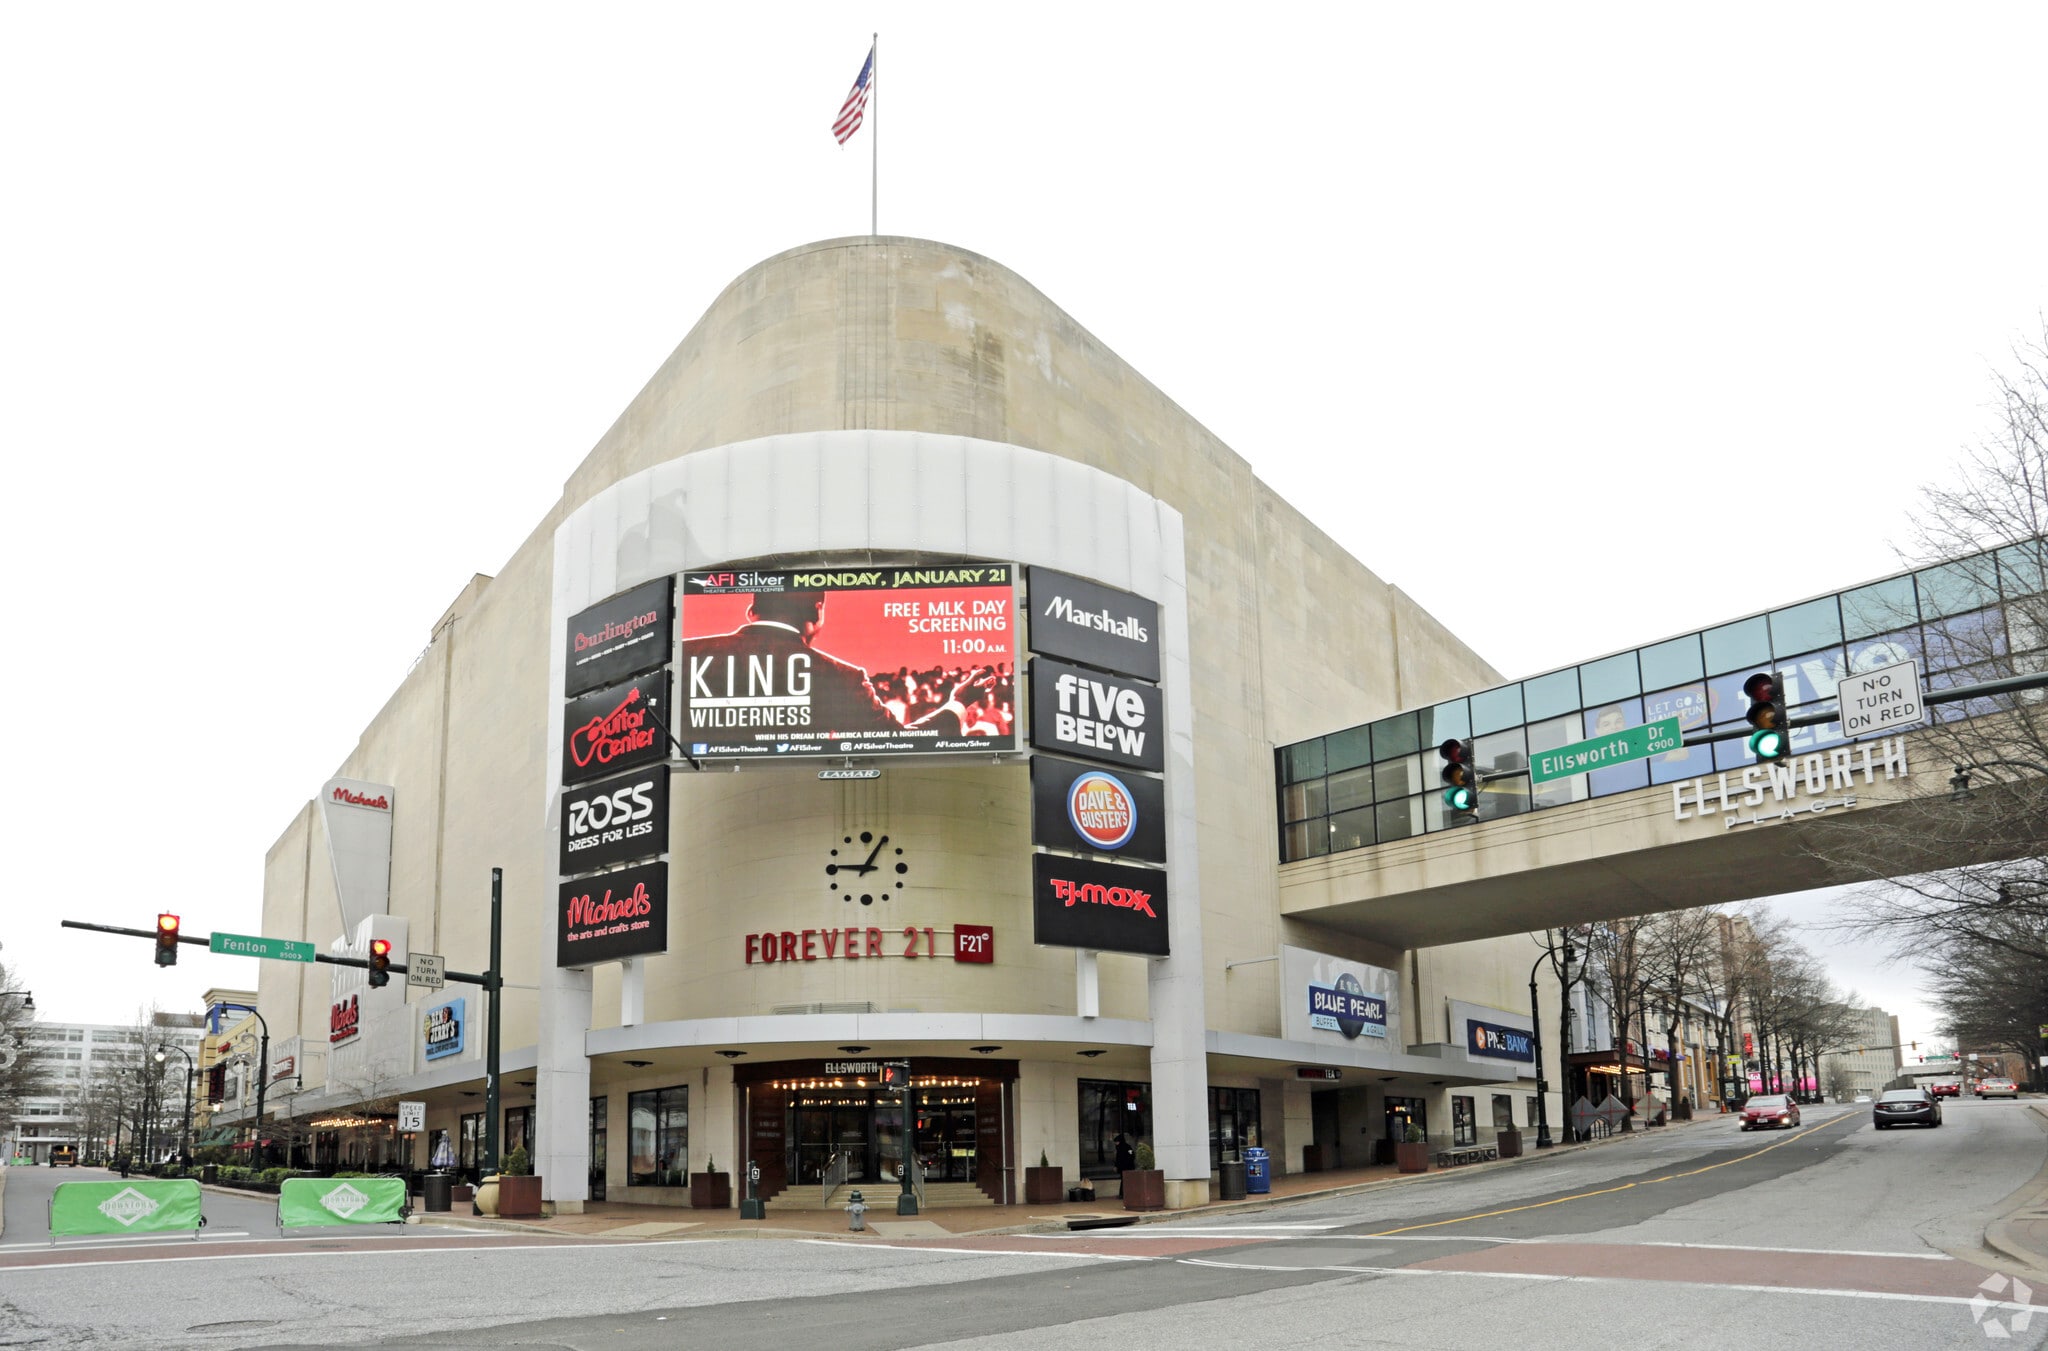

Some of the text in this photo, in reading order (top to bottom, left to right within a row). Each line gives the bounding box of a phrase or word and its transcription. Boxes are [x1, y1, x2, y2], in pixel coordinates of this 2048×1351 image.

[705, 569, 1006, 588] AFI Silver MONDAY, JANUARY 21
[884, 600, 1007, 617] FREE MLK DAY
[1045, 595, 1148, 643] Marshalls
[575, 610, 657, 653] Burlington
[908, 616, 1007, 633] SCREENING
[943, 638, 985, 654] 11:00
[690, 653, 811, 698] KING
[1863, 675, 1891, 693] NO
[1055, 673, 1146, 728] five
[1647, 693, 1705, 716] LET GO &
[1857, 688, 1903, 710] TURN
[690, 706, 811, 728] WILDERNESS
[1849, 703, 1915, 730] ON RED
[755, 733, 776, 741] WHEN
[831, 731, 862, 739] AMERICA
[1648, 726, 1664, 740] Dr
[1654, 737, 1674, 750] 900
[597, 727, 655, 763] Center
[1542, 739, 1629, 775] Ellsworth
[1672, 736, 1908, 820] ELLSWORTH
[333, 787, 388, 810] Michaels
[569, 781, 654, 837] ROSS
[1079, 791, 1127, 810] DAVE &
[1080, 811, 1128, 829] BUSTER'S
[1724, 793, 1857, 830] PLACE
[568, 821, 653, 853] DRESS FOR LESS
[567, 882, 651, 929] Michaels
[567, 920, 650, 942] the arts and crafts store
[223, 938, 294, 953] Fenton St
[746, 926, 935, 964] FOREVER 21
[960, 934, 983, 953] F21
[416, 966, 437, 975] TURN
[420, 958, 434, 966] NO
[410, 974, 441, 984] ON RED
[1315, 991, 1383, 1020] BLUE PEARL
[1506, 1034, 1529, 1054] BANK
[825, 1062, 878, 1074] ELLSWORTH
[404, 1116, 420, 1127] 15
